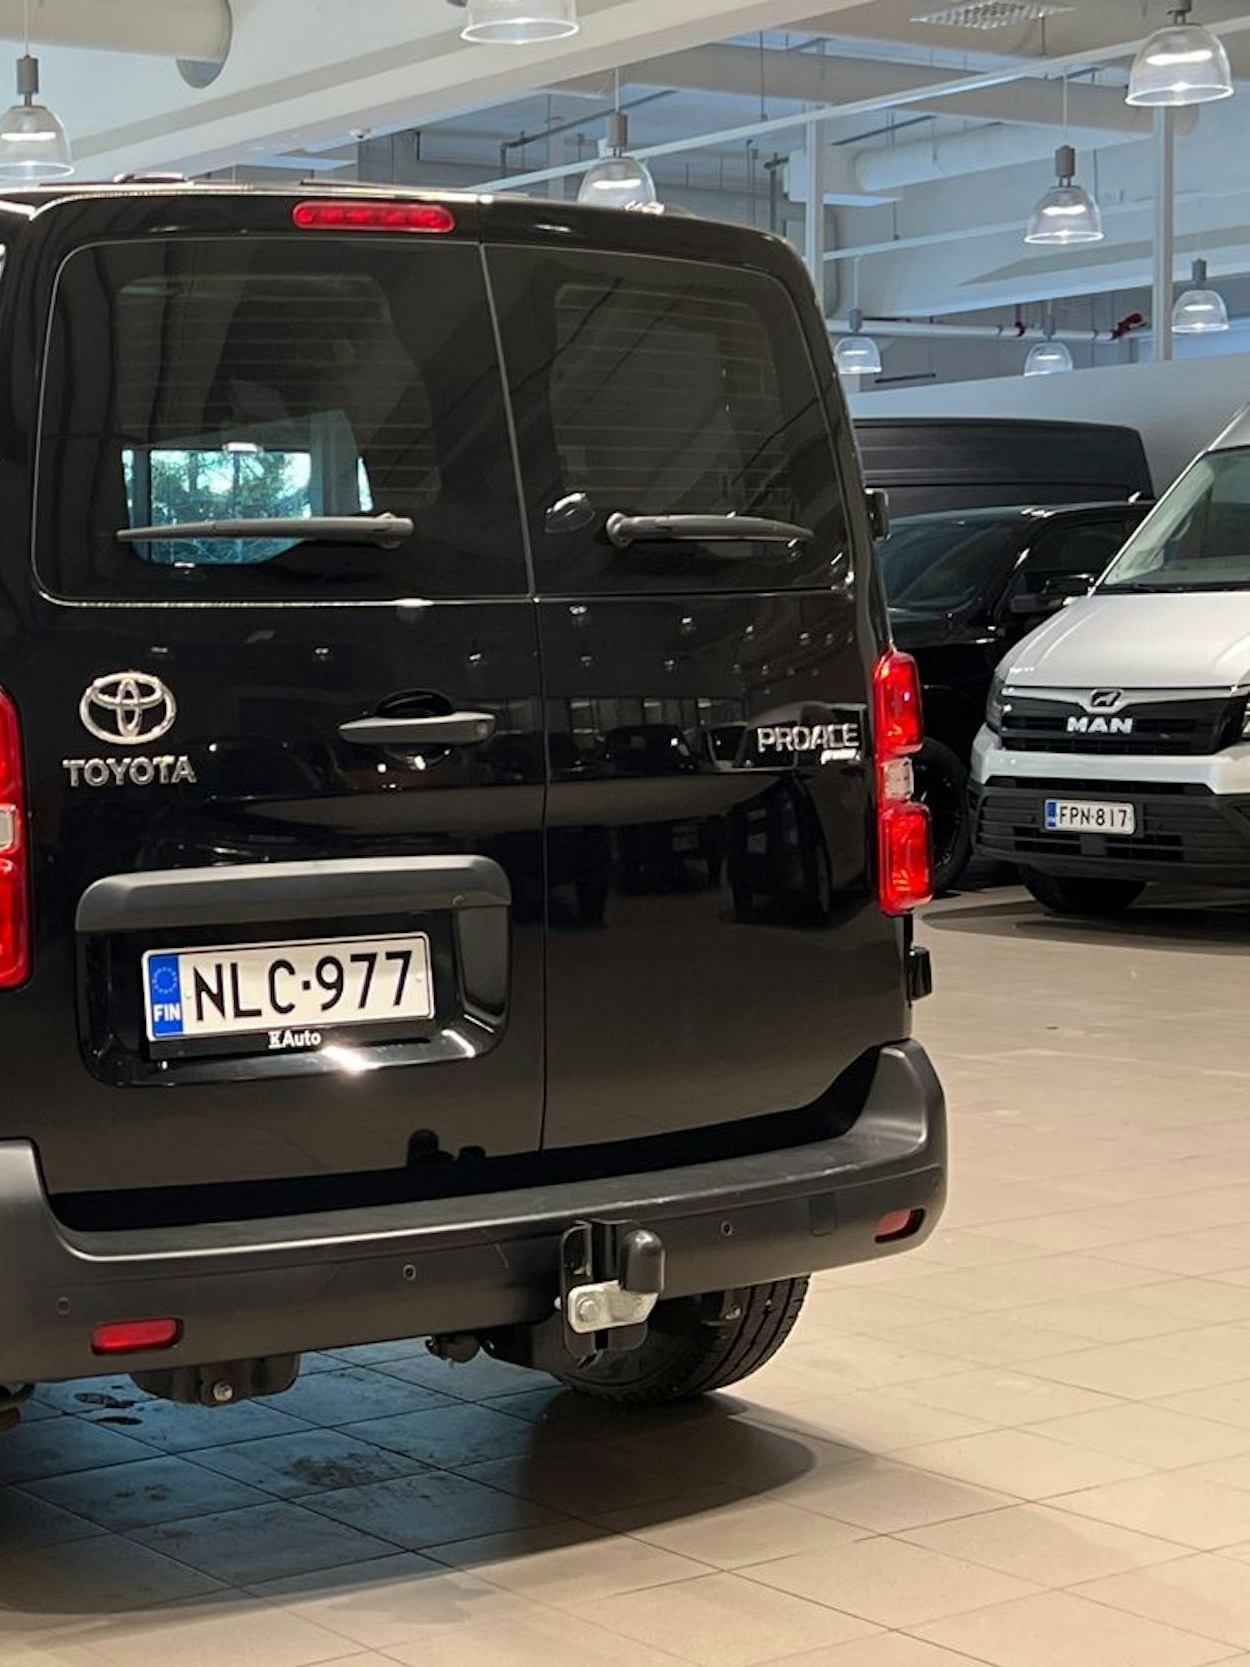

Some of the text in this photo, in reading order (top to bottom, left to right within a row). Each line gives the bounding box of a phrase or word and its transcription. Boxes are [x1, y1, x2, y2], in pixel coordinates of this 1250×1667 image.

[1066, 716, 1133, 734] MAN
[757, 723, 860, 753] PROACE
[62, 755, 198, 787] TOYOTA
[154, 1002, 181, 1023] FIN
